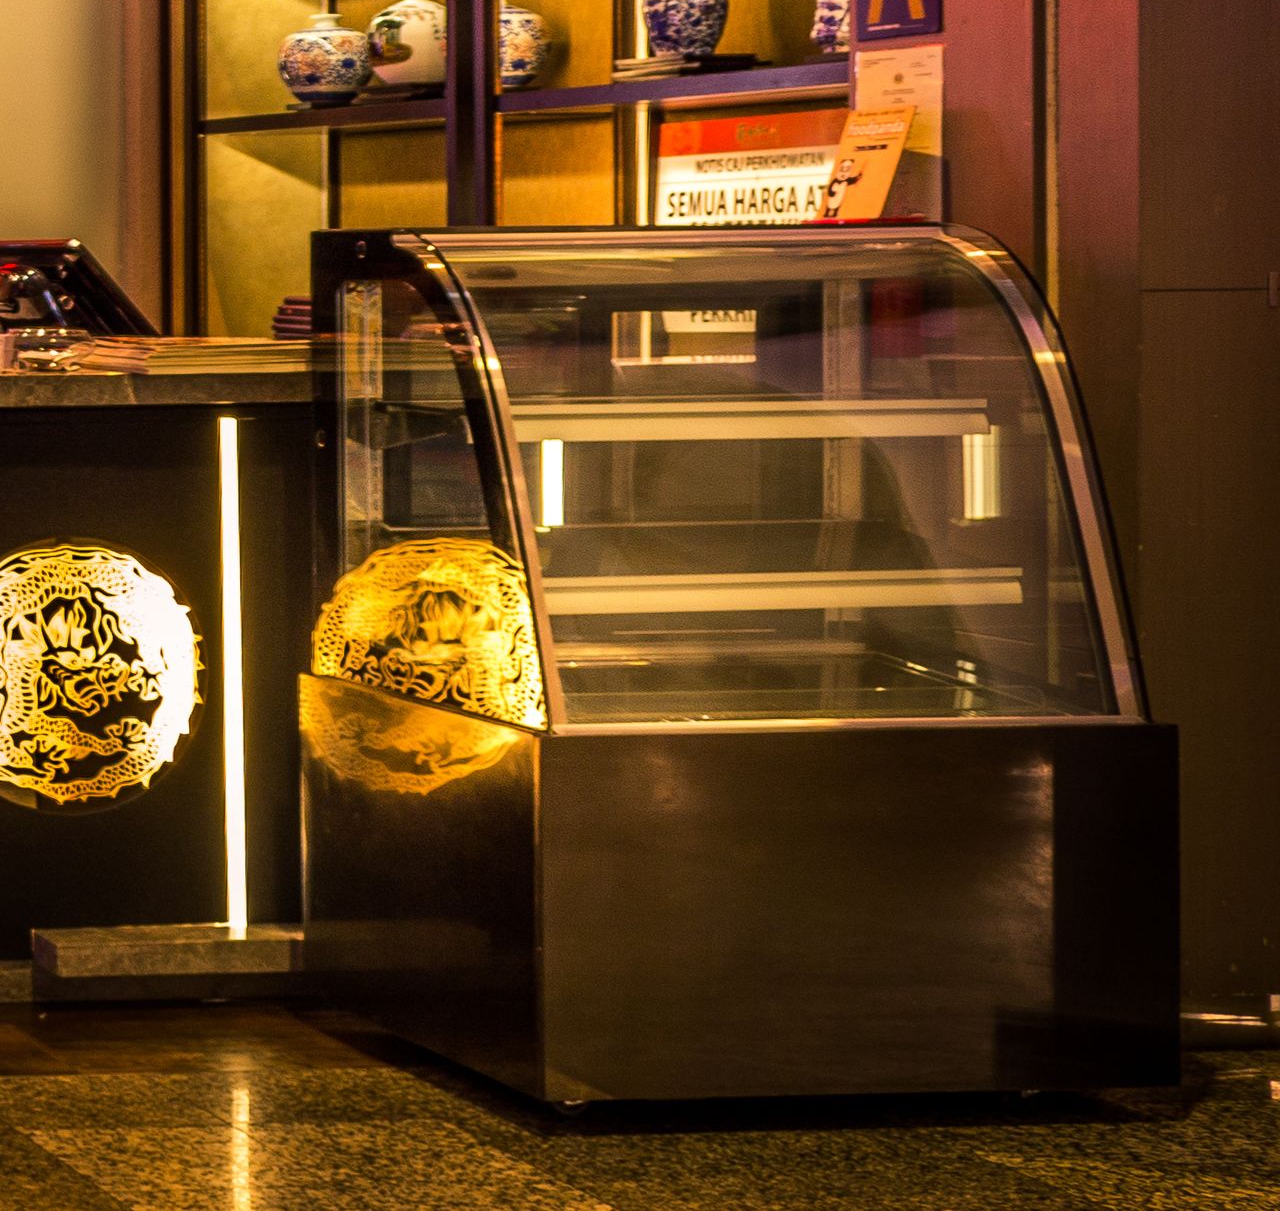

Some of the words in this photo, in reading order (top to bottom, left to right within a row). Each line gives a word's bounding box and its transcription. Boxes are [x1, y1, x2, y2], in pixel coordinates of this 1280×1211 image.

[694, 158, 724, 174] NOTIS
[725, 156, 745, 173] CAJ
[746, 151, 826, 172] PERKHIDMATAN
[667, 189, 728, 218] SEMUA
[733, 185, 799, 215] HARGA
